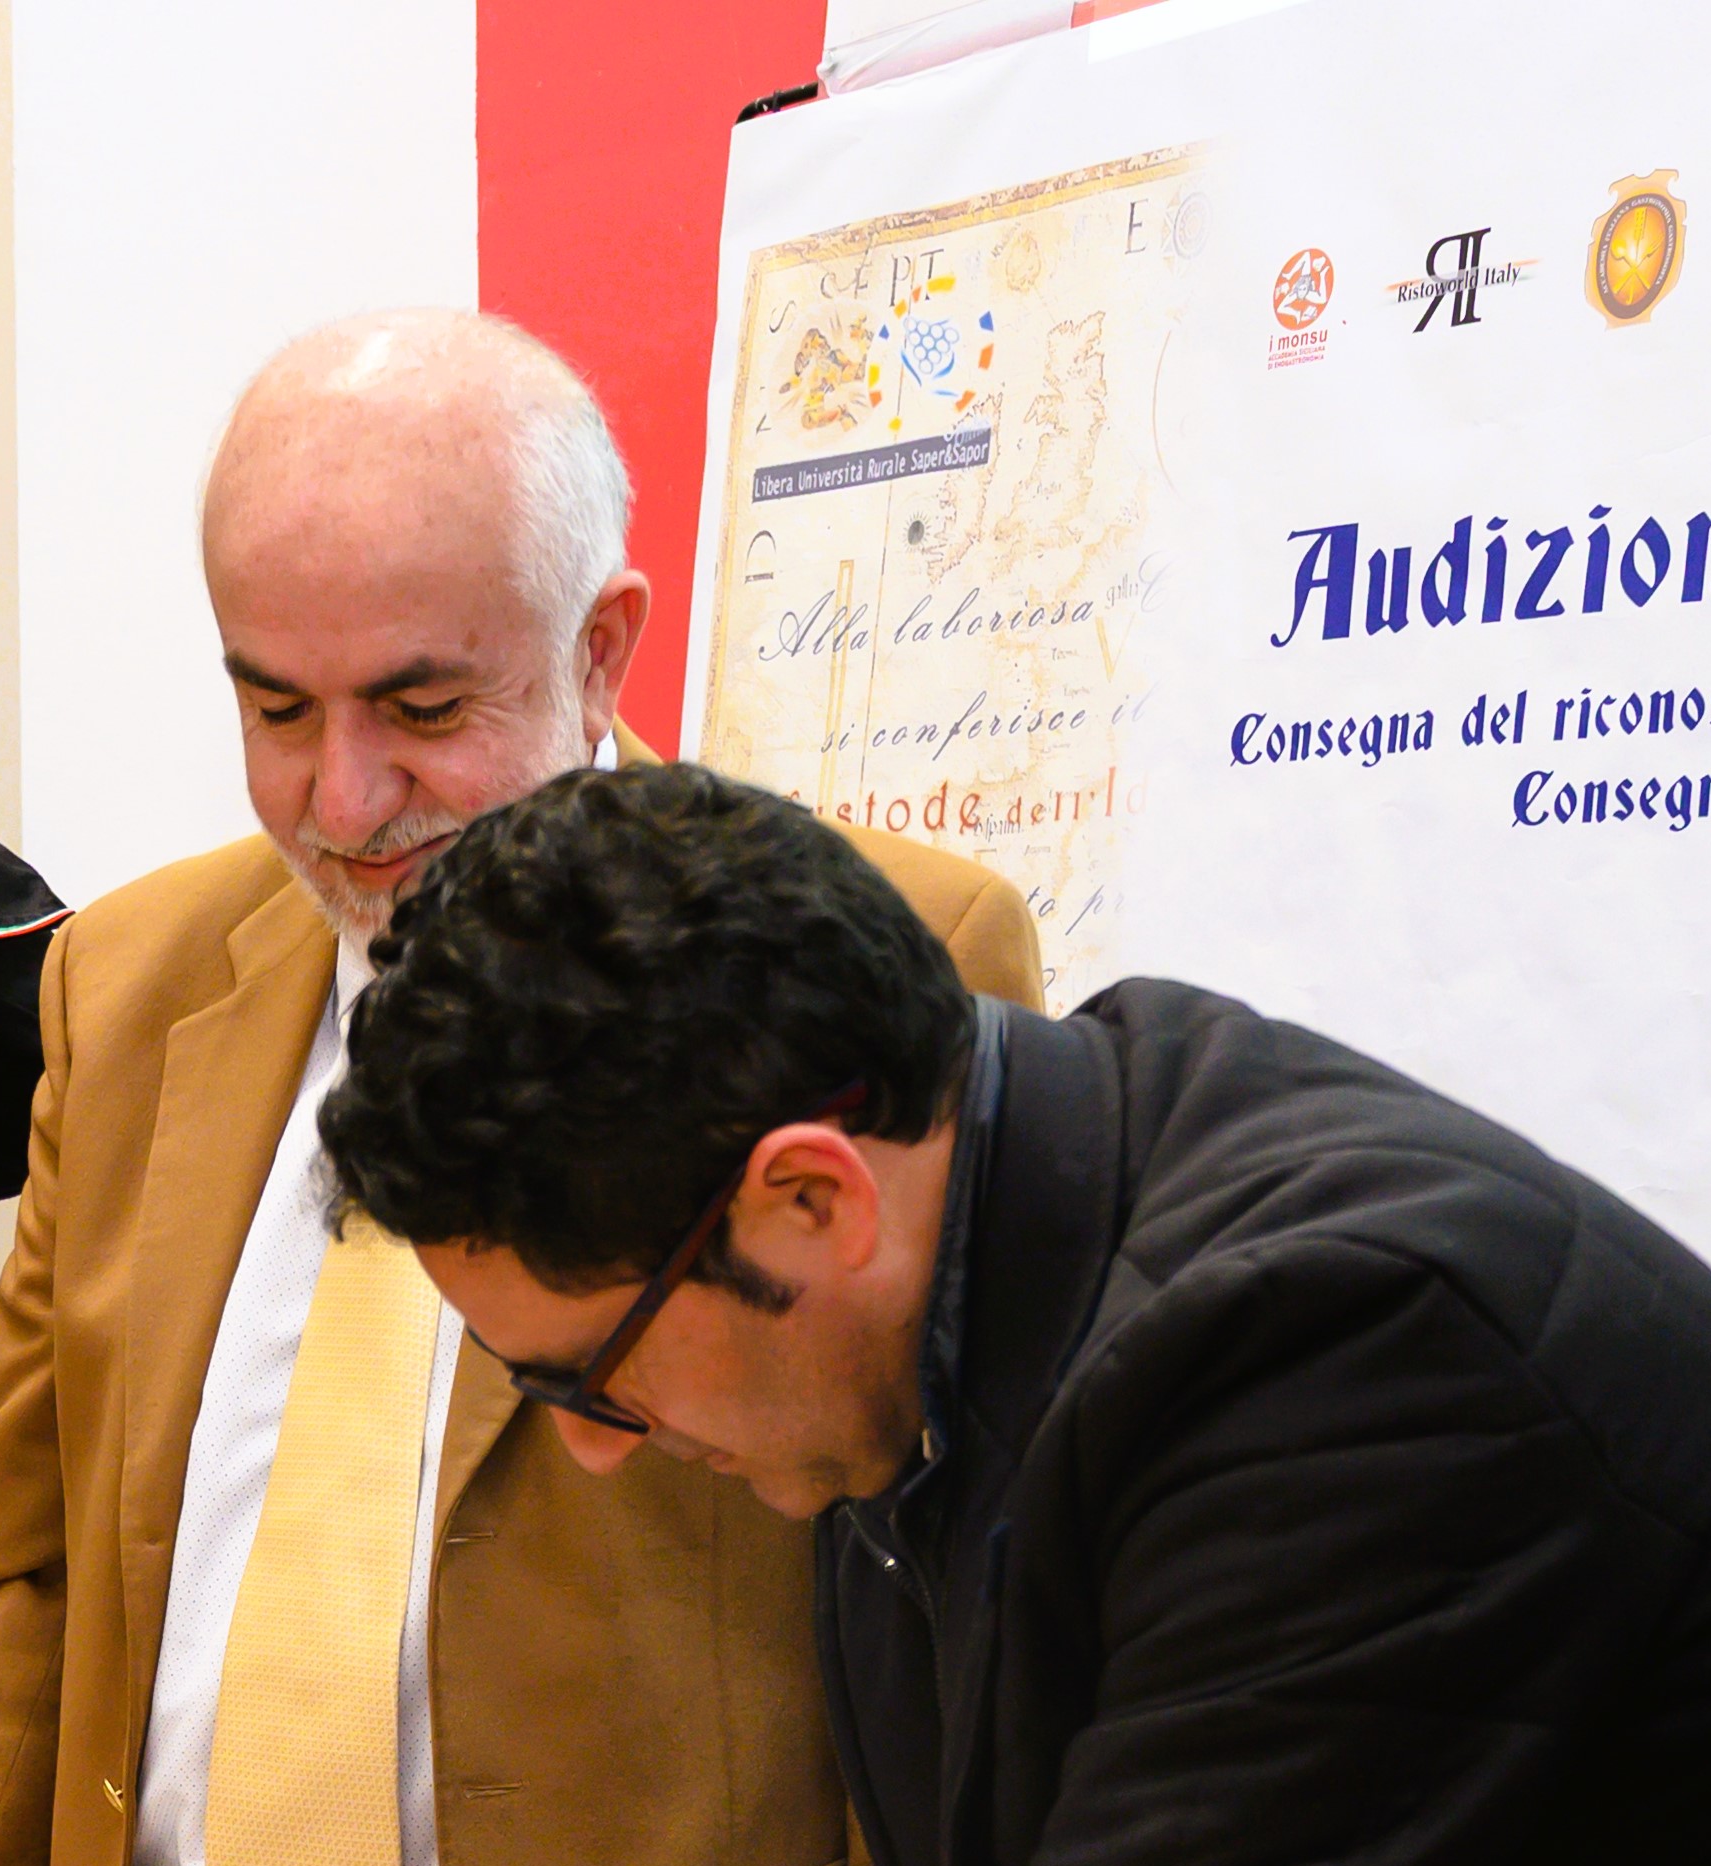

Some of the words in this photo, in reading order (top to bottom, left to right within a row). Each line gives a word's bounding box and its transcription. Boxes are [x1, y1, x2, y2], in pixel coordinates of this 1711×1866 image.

[1396, 268, 1480, 303] Ristoworld
[1483, 262, 1522, 288] Italy
[1277, 329, 1329, 351] monsu
[753, 476, 794, 499] Libera
[797, 464, 864, 492] Università
[867, 453, 906, 480] Rurale
[758, 589, 871, 663] Alla
[892, 586, 1095, 646] laboriosa
[820, 723, 855, 755] si
[871, 690, 1088, 762] conferisce
[1230, 709, 1435, 765] Consegna
[1461, 690, 1528, 746] del
[784, 781, 983, 835] stode
